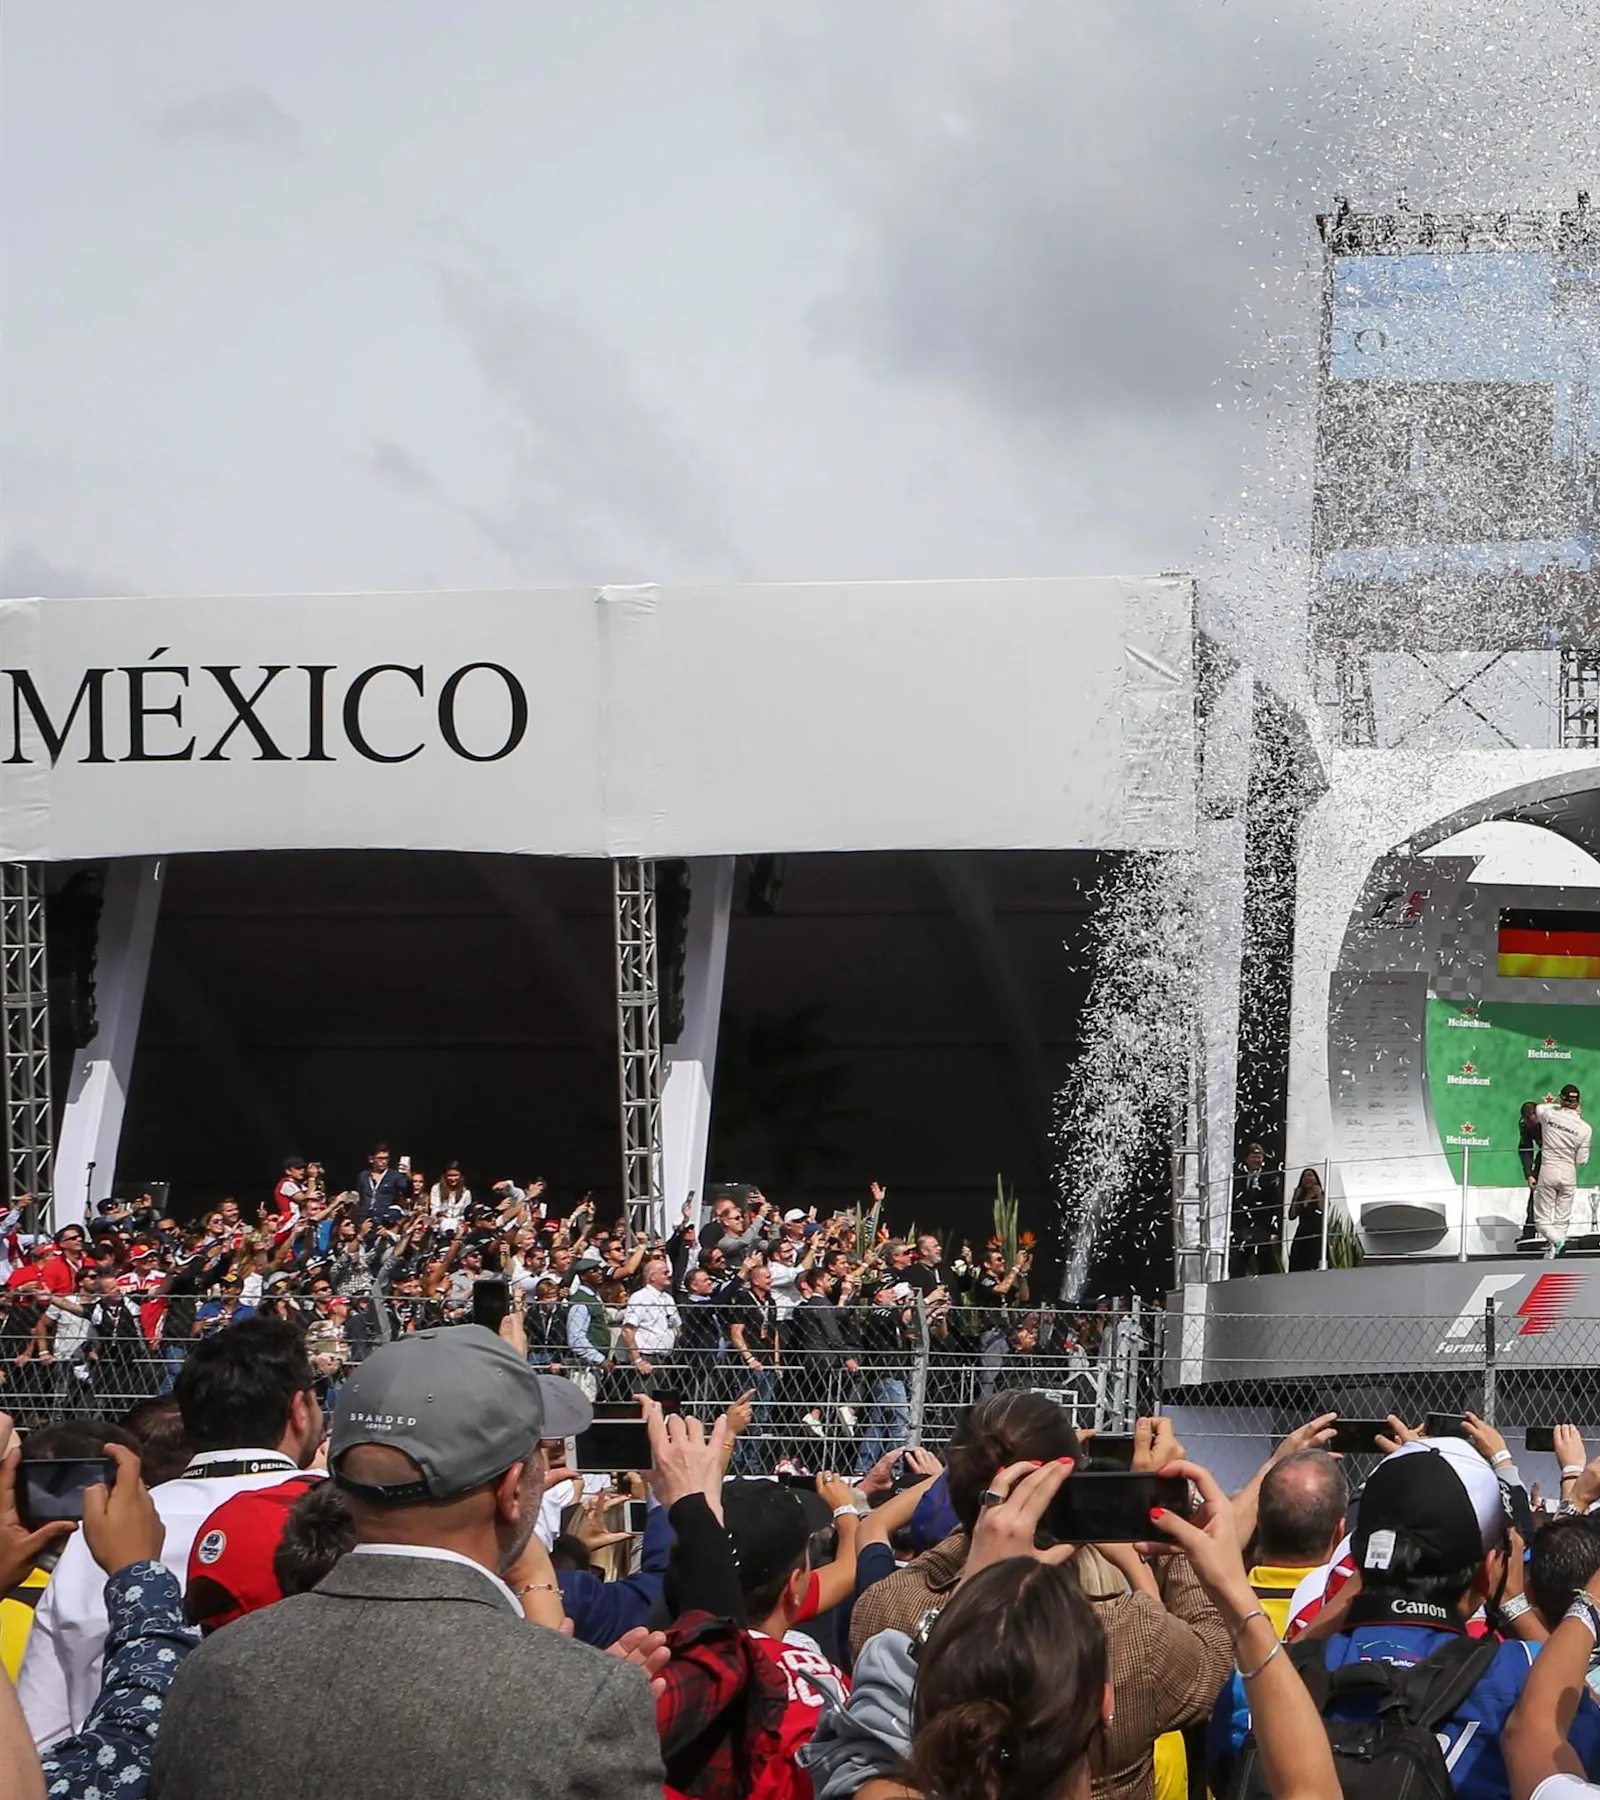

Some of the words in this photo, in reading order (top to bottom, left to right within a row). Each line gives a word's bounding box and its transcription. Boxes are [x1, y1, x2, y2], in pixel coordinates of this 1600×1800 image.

[0, 646, 529, 770] MÉXICO
[1448, 1017, 1492, 1029] Heineken
[1527, 1049, 1572, 1060] Heineken
[1447, 1074, 1491, 1087] Heineken
[1446, 1134, 1490, 1147] Heineken
[350, 1412, 417, 1426] BRANDED
[1391, 1598, 1448, 1619] Canon
